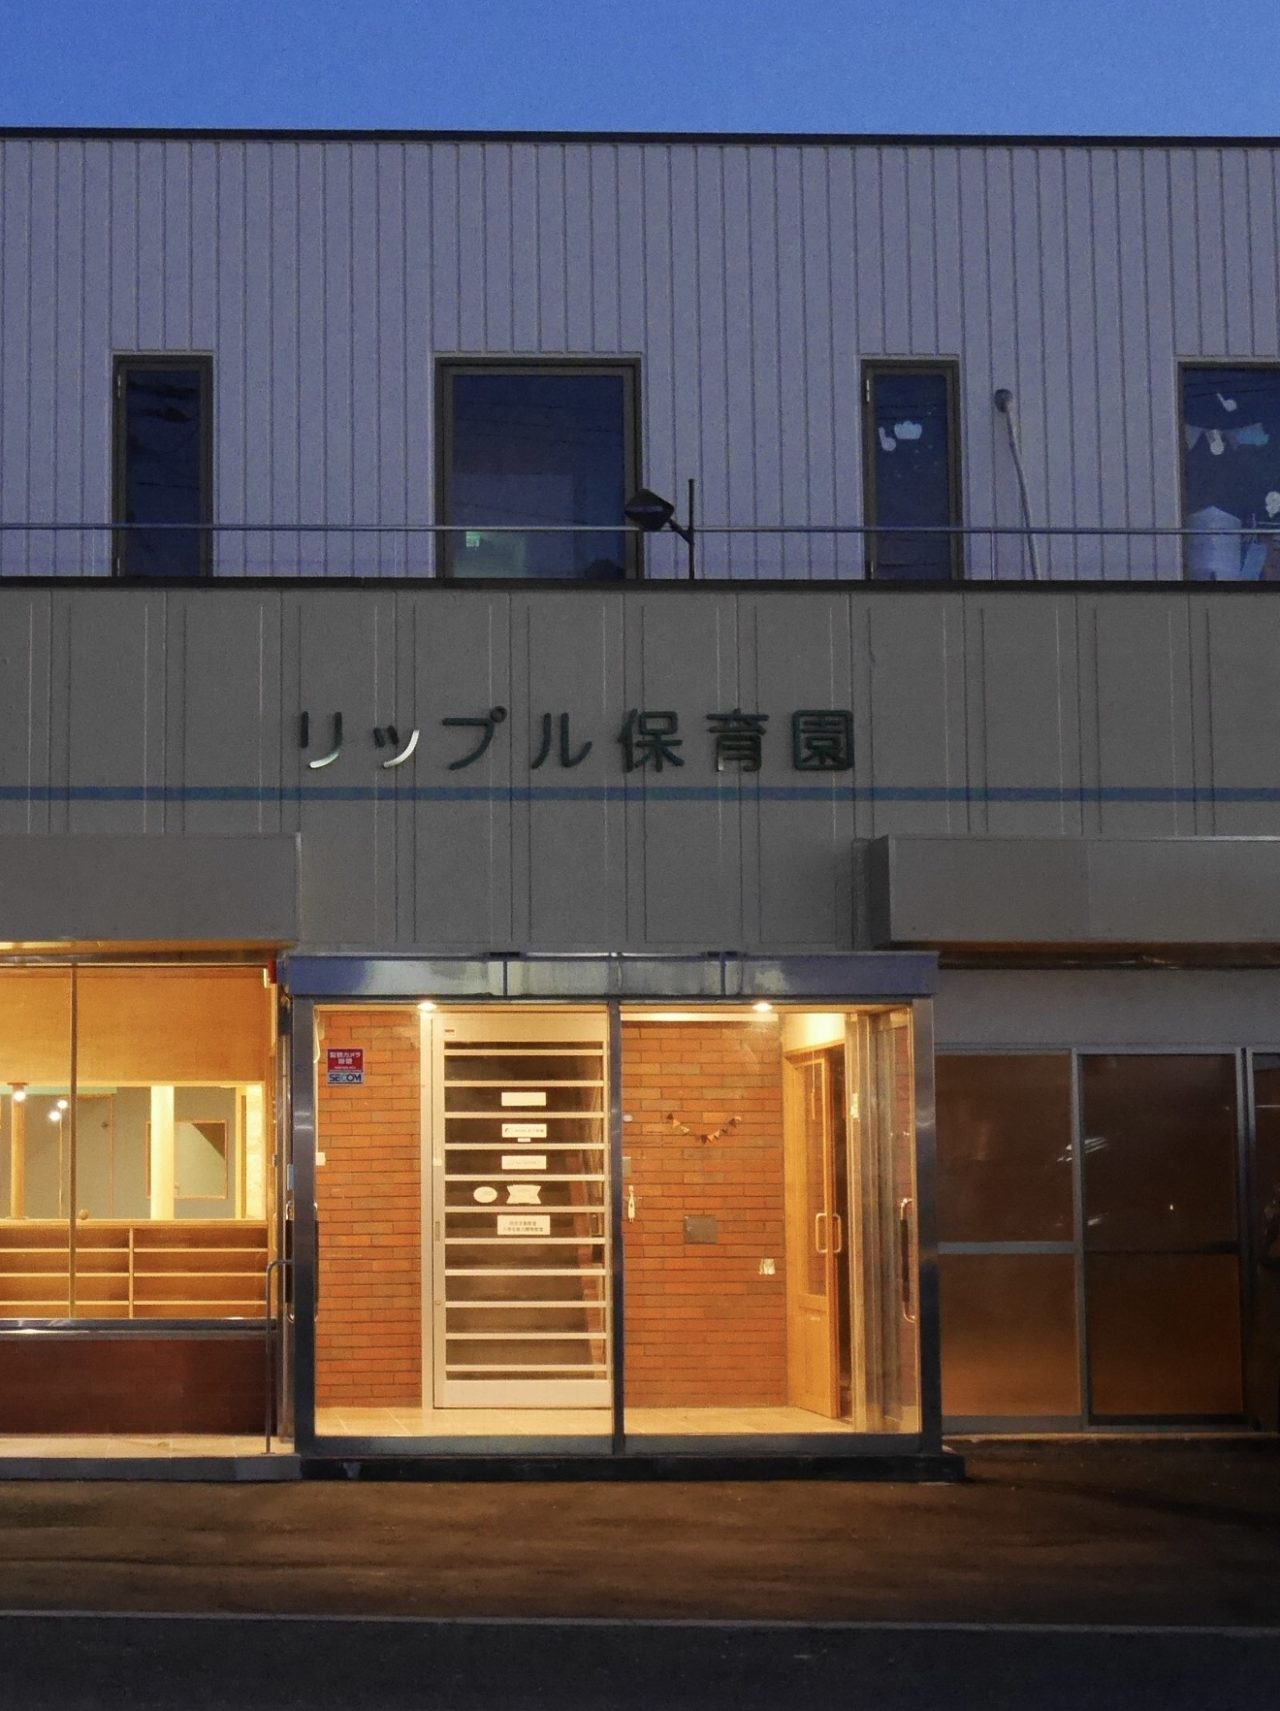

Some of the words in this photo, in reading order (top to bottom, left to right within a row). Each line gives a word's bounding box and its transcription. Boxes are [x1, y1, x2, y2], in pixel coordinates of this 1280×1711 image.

[300, 705, 855, 773] リップル保育園
